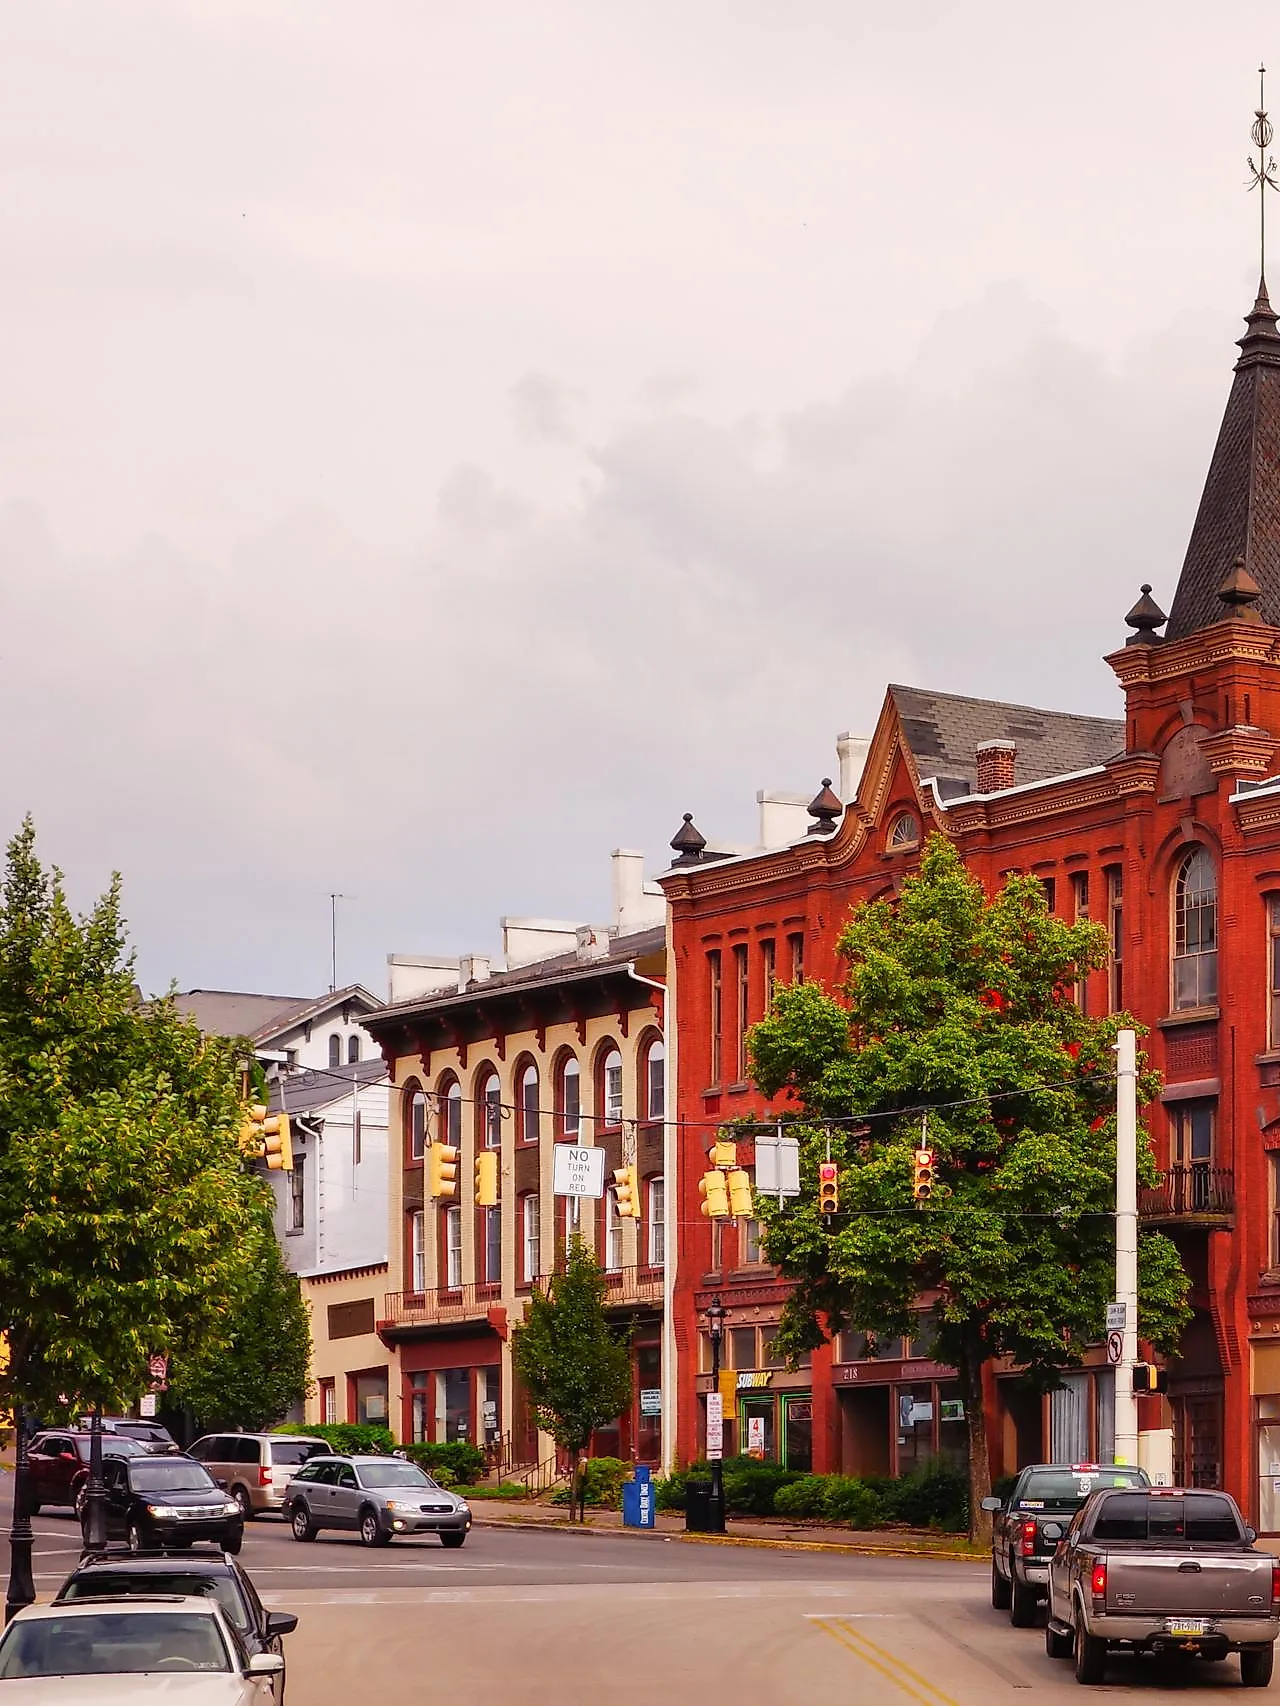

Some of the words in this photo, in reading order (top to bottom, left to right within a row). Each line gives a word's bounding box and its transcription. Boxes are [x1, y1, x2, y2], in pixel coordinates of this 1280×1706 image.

[569, 1150, 589, 1162] NO
[568, 1163, 590, 1172] TURN
[572, 1174, 584, 1182] ON
[569, 1183, 586, 1192] RED
[843, 1367, 859, 1380] 218
[736, 1371, 772, 1389] SUBWAY
